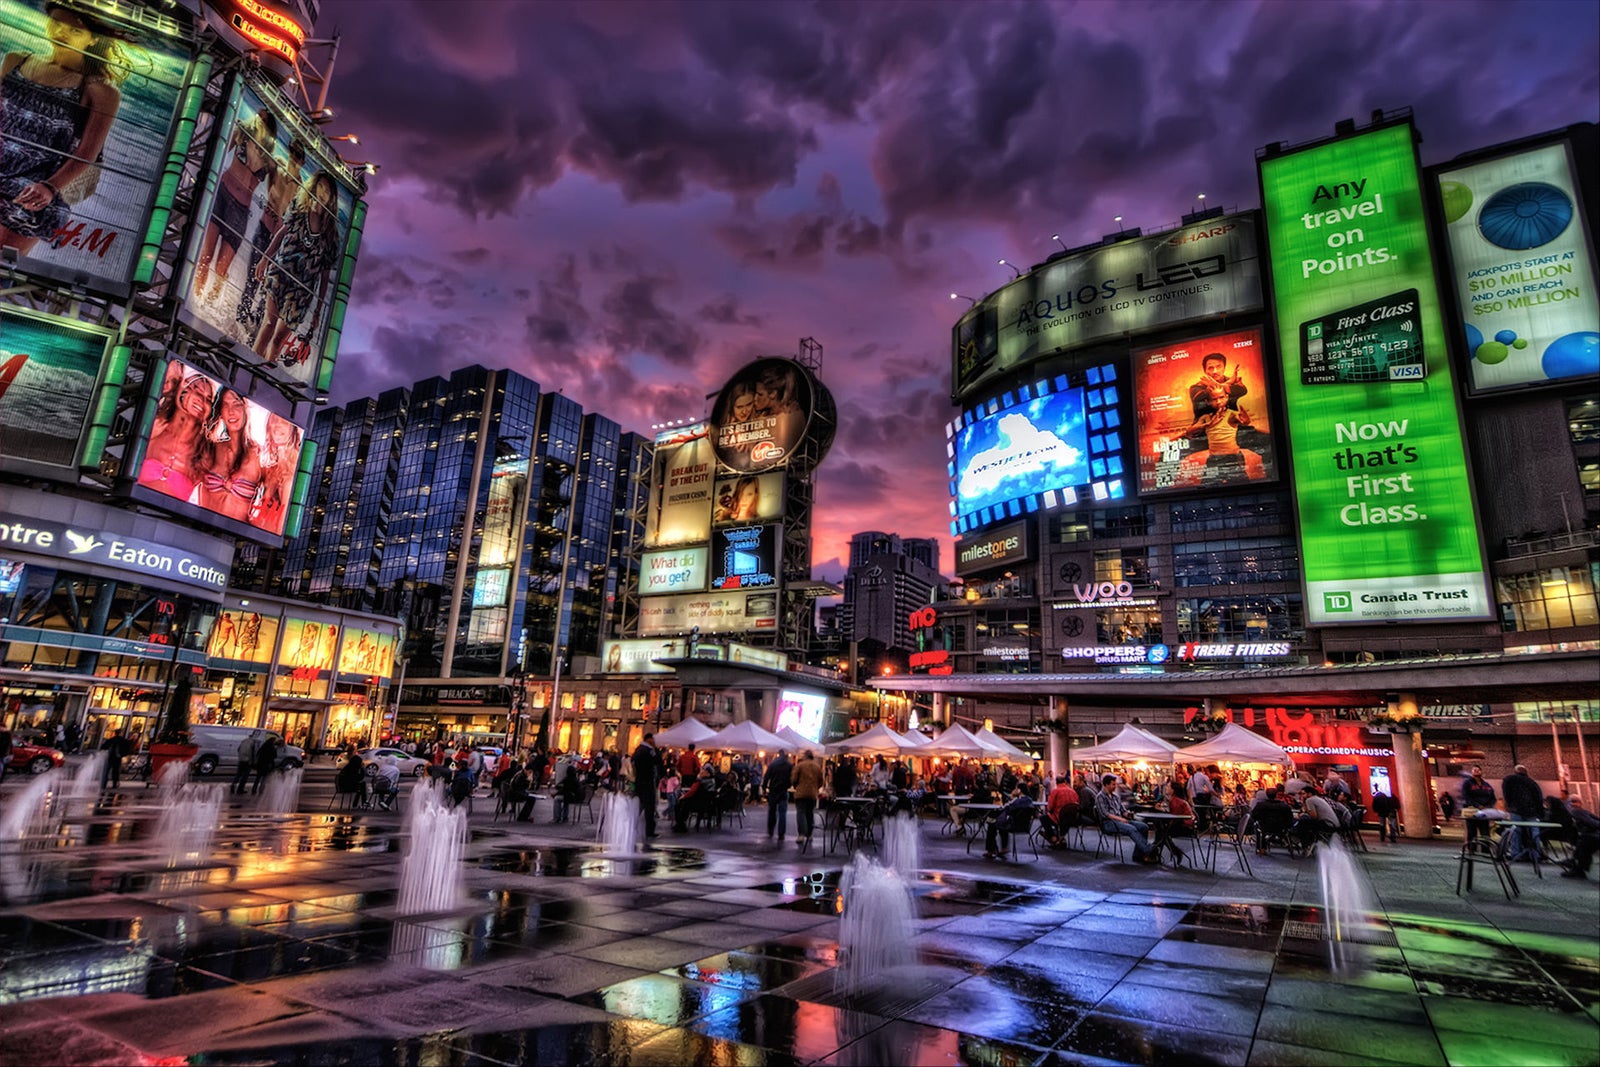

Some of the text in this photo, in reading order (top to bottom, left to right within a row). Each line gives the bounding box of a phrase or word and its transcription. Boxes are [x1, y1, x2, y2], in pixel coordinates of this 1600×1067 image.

[1312, 178, 1367, 204] Any
[1301, 193, 1383, 229] travel
[48, 219, 118, 257] H&M
[1168, 223, 1236, 247] SHARP
[1327, 228, 1364, 248] on
[1302, 247, 1398, 279] Points.
[1467, 251, 1575, 279] JACKPOTS START AT
[1468, 263, 1572, 292] $10 MILLION
[1016, 254, 1226, 328] AQUOS LED
[1471, 280, 1563, 302] AND CAN REACH
[1473, 287, 1580, 316] $50 MILLION
[1025, 284, 1213, 337] THE EVOLUTION OF LCD TV CONTINUES.
[1337, 302, 1414, 330] First Class
[1308, 324, 1322, 338] TD
[1327, 350, 1347, 360] 1234
[1351, 346, 1374, 356] 5678
[1380, 340, 1408, 352] 9123
[1393, 367, 1421, 377] VISA
[735, 420, 764, 433] BETTER
[767, 417, 776, 427] TO
[1335, 419, 1408, 443] Now
[719, 429, 771, 446] BE A MEMBER.
[1153, 438, 1190, 453] Karate
[1162, 449, 1180, 462] Kid
[1333, 443, 1418, 471] that's
[670, 473, 709, 487] OF THE CITY
[671, 463, 708, 477] BREAK OUT
[1347, 472, 1414, 498] First
[1340, 502, 1427, 526] Class.
[961, 536, 1018, 563] milestones
[109, 541, 226, 587] Eaton Centre
[650, 554, 694, 569] What did
[648, 569, 691, 588] you get?
[861, 577, 887, 585] DELTA
[1073, 581, 1133, 602] WOO
[1325, 589, 1468, 610] TD Canada Trust
[1362, 609, 1390, 618] Banking
[1403, 607, 1412, 615] be
[1413, 606, 1427, 614] this
[1427, 605, 1471, 614] comfortable
[983, 646, 1029, 656] milestones
[1062, 645, 1146, 658] SHOPPERS
[1095, 655, 1147, 664] DRUG MART
[1177, 641, 1290, 661] EXTREME FITNESS
[1286, 745, 1389, 757] OPERA COMEDY MUSIC
